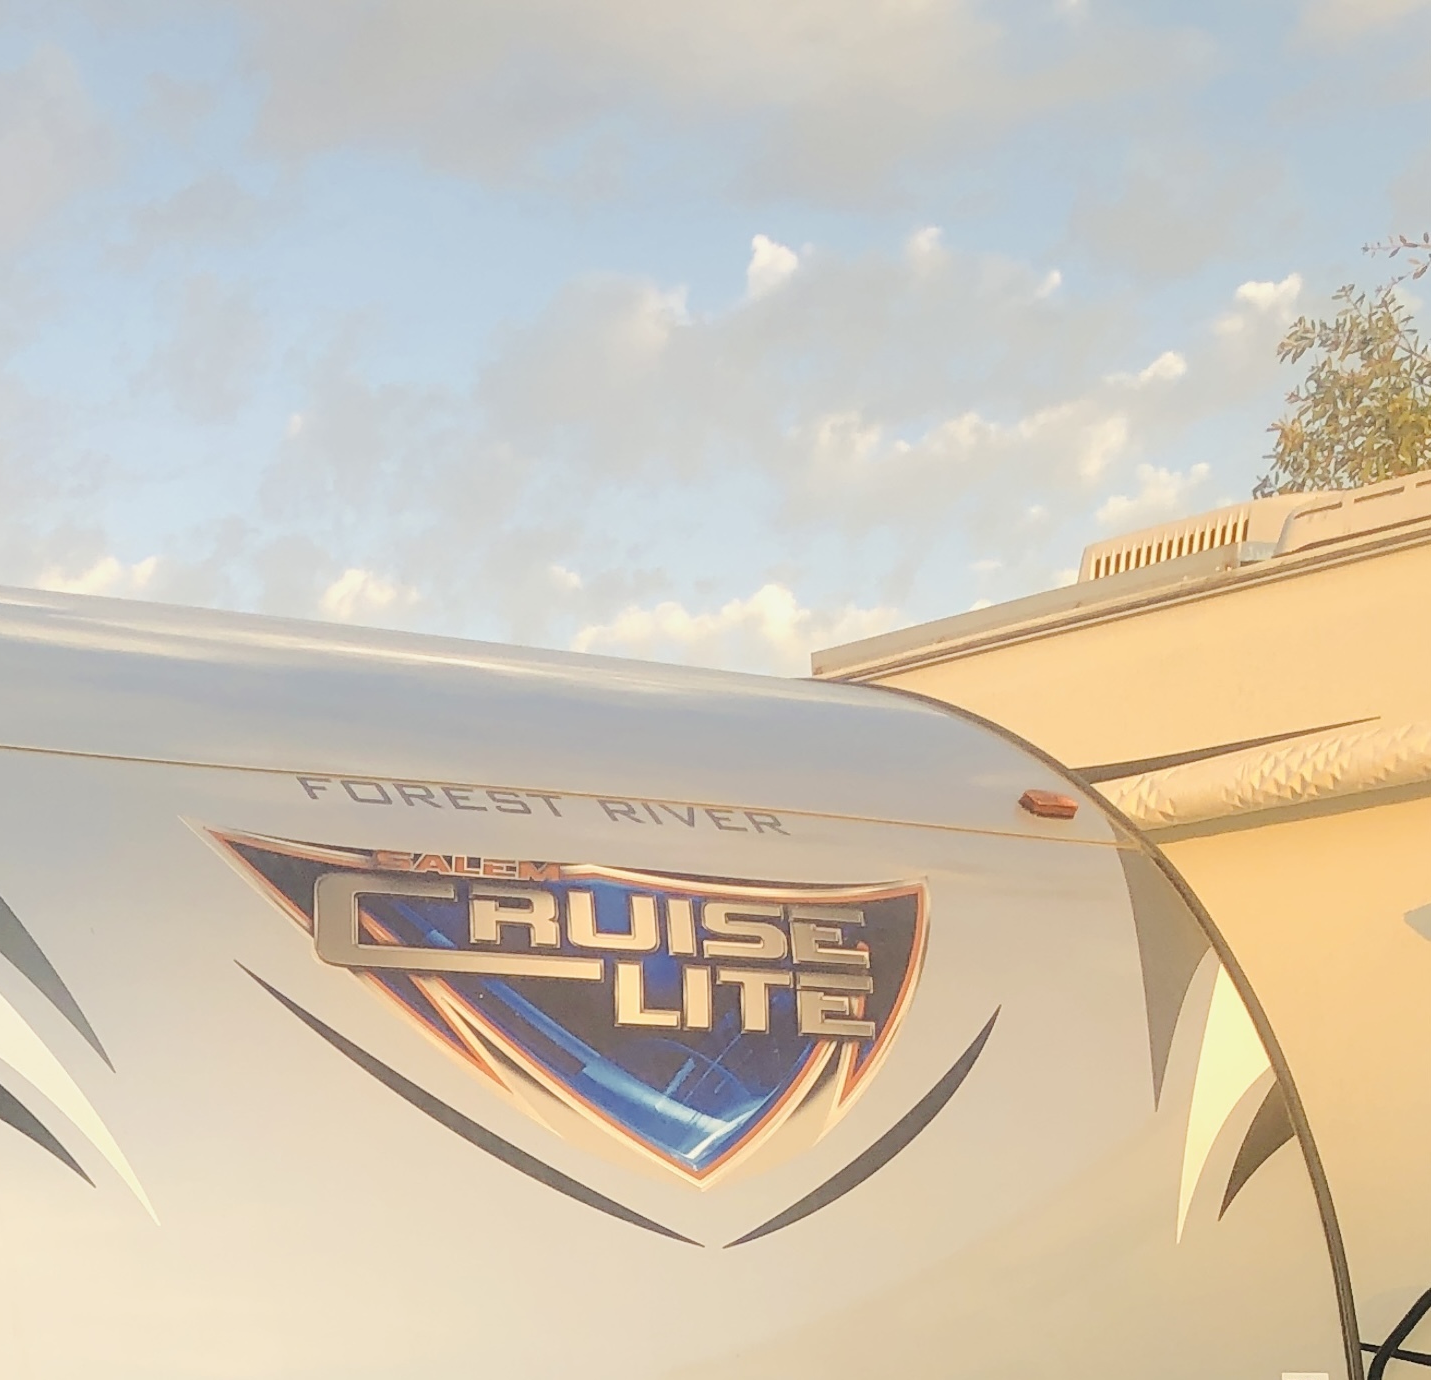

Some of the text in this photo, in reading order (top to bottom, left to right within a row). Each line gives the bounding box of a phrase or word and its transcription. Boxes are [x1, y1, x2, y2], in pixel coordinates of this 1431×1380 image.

[296, 776, 791, 836] FOREST RIVER
[370, 849, 562, 882] SALEM
[313, 872, 871, 982] CRUISE
[613, 960, 875, 1038] LITE
